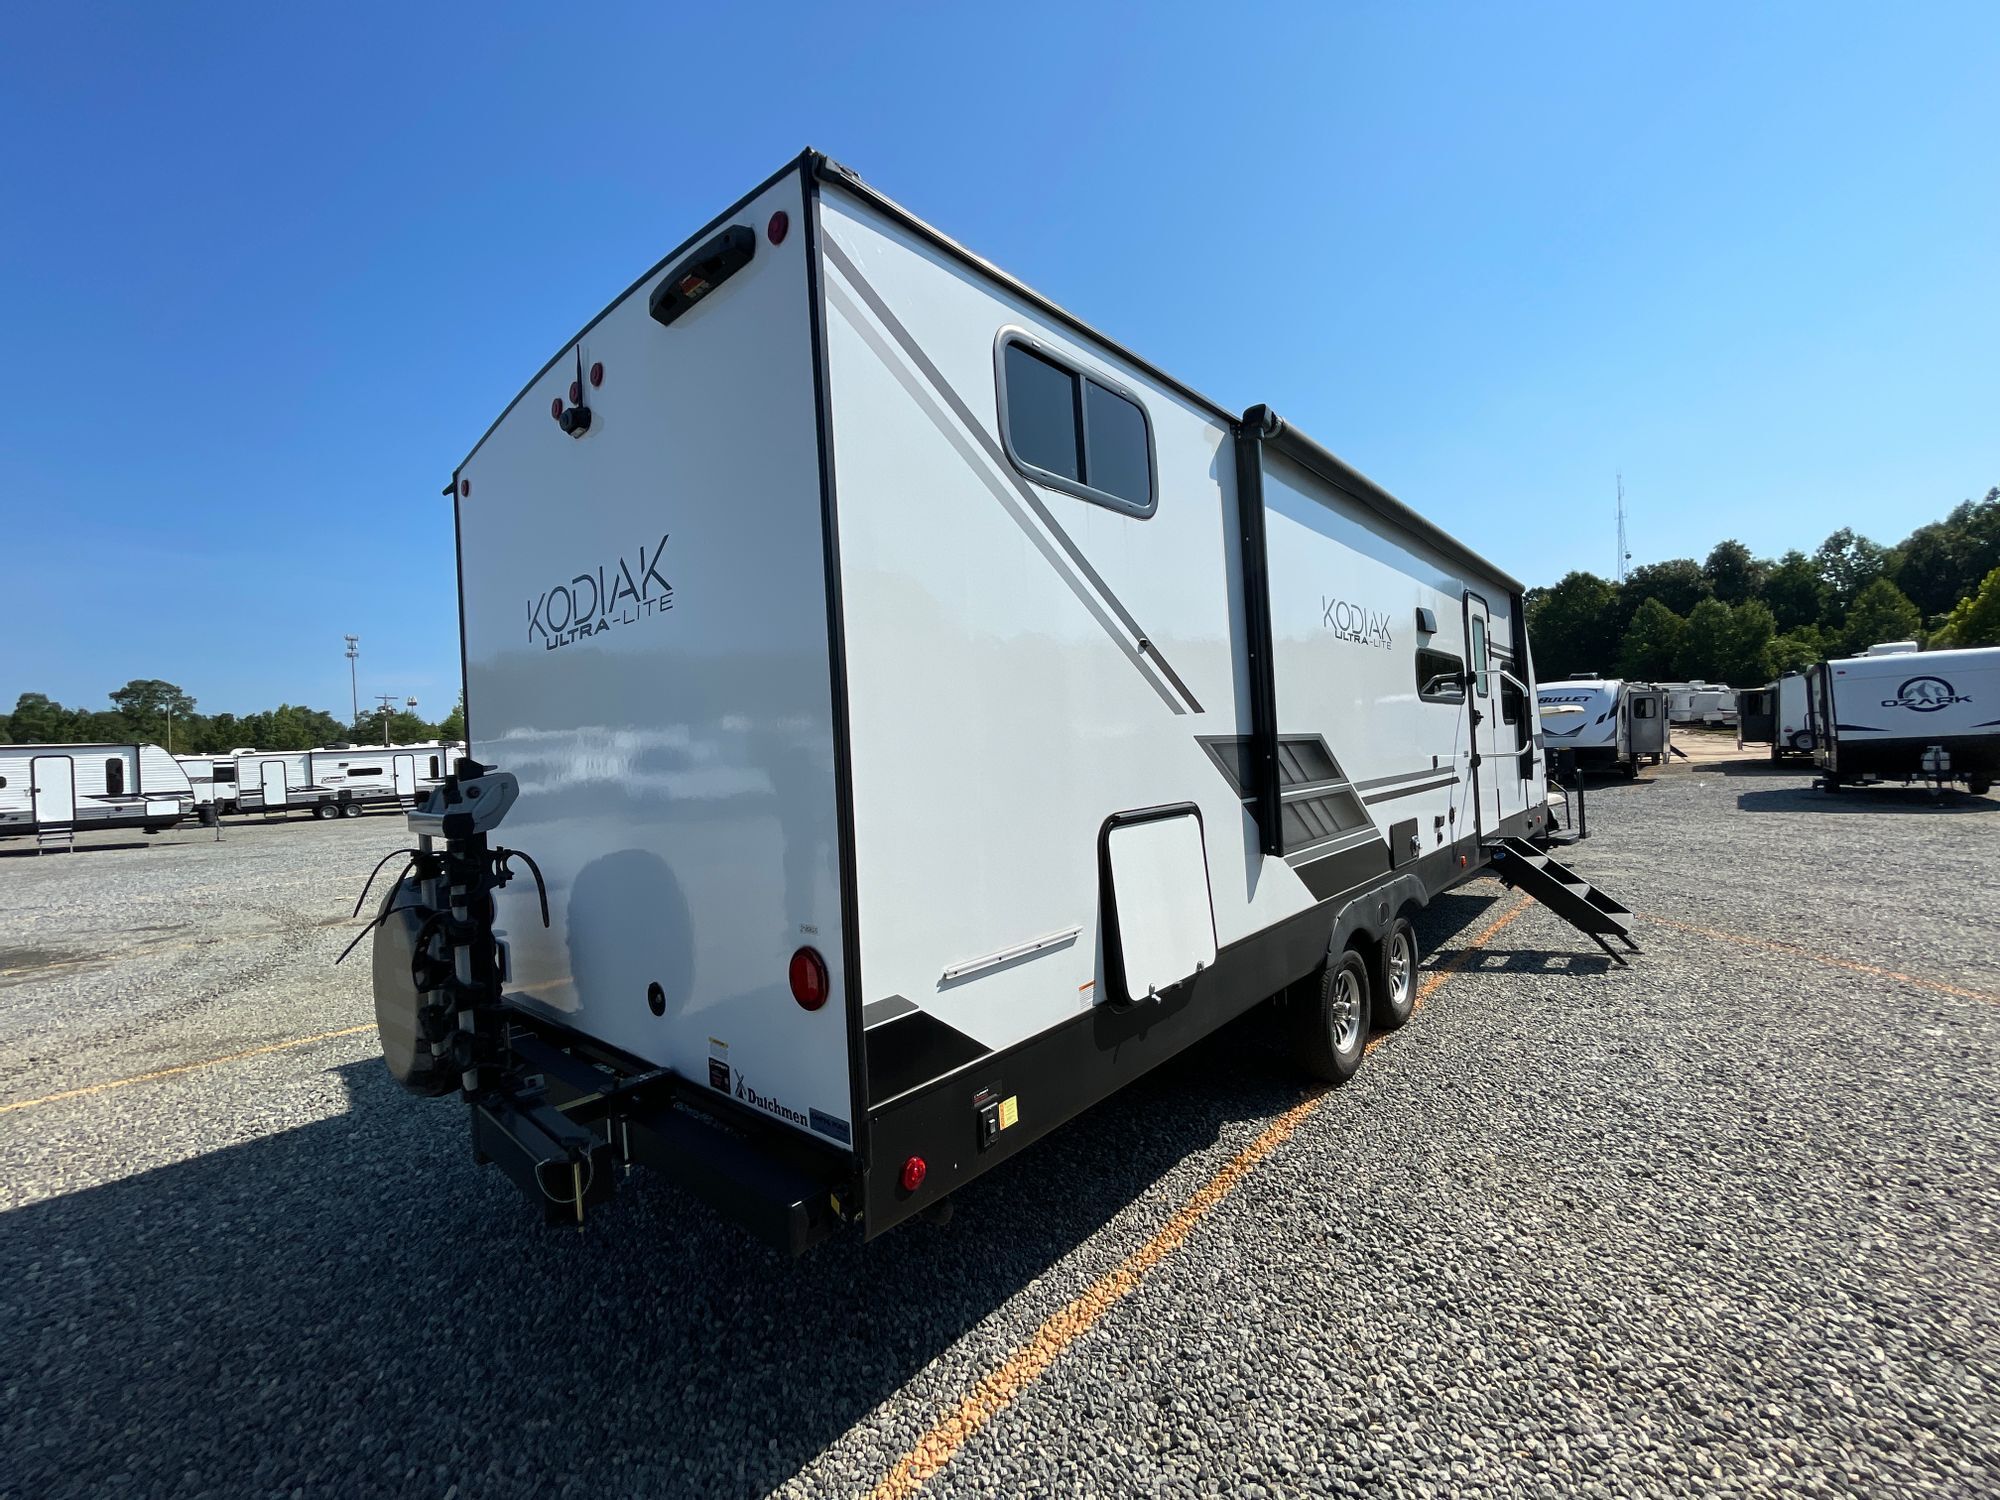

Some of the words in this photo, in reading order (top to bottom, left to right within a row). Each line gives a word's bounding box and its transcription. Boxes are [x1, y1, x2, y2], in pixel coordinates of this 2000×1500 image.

[527, 534, 673, 643] KODIAK
[546, 592, 674, 651] ULTRA-LITE
[1322, 595, 1392, 641] KODIAK
[1334, 630, 1392, 650] ULTRA-LITE
[1538, 696, 1592, 704] BULLET
[1881, 694, 1973, 707] OZARK
[747, 1088, 809, 1128] Dutchmen
